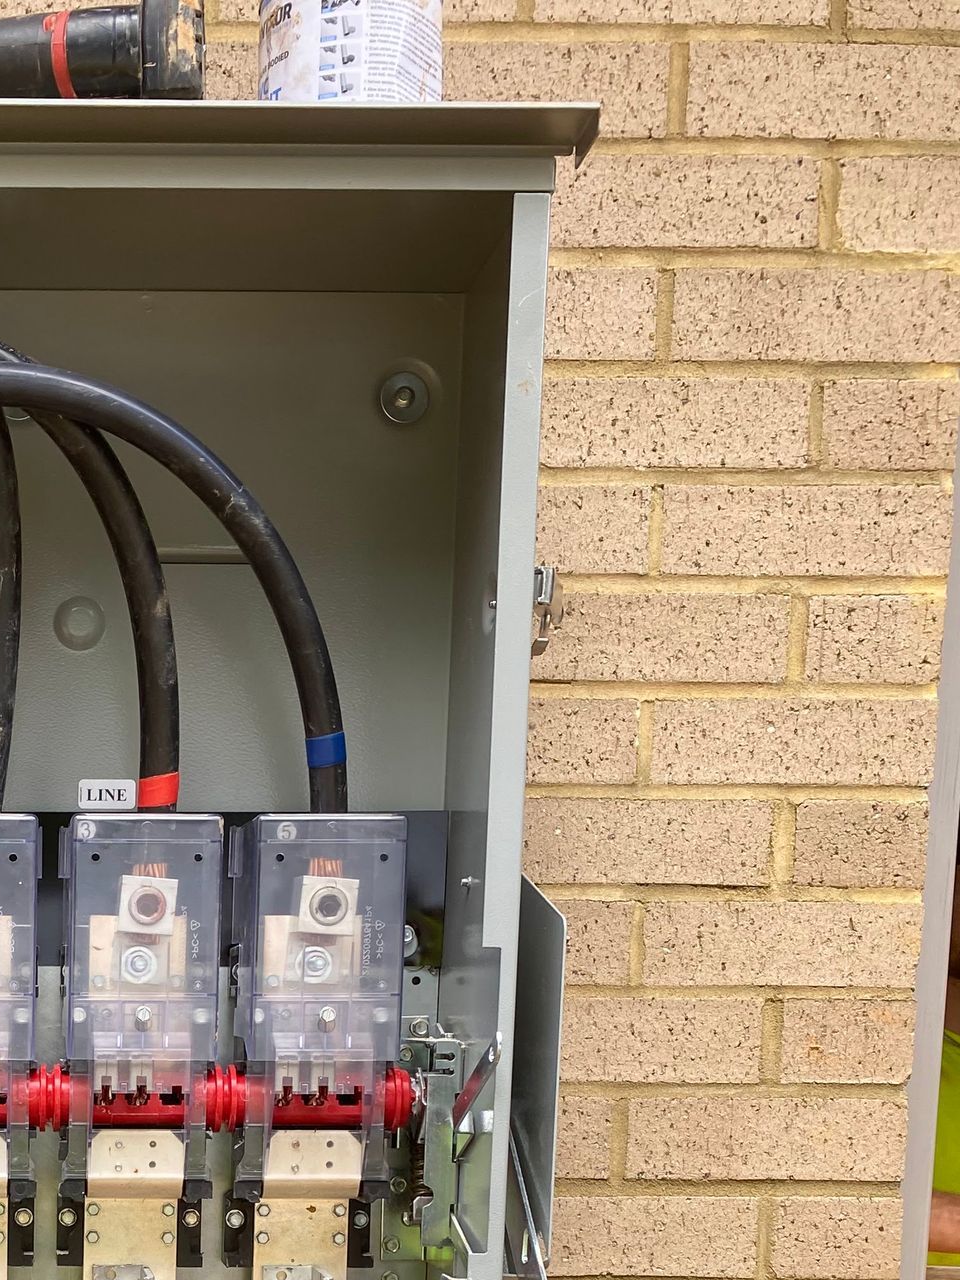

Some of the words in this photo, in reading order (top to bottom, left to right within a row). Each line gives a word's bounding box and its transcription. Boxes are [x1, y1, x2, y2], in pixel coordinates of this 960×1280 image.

[86, 788, 128, 802] LINE
[80, 821, 91, 838] 3
[282, 824, 291, 839] 5
